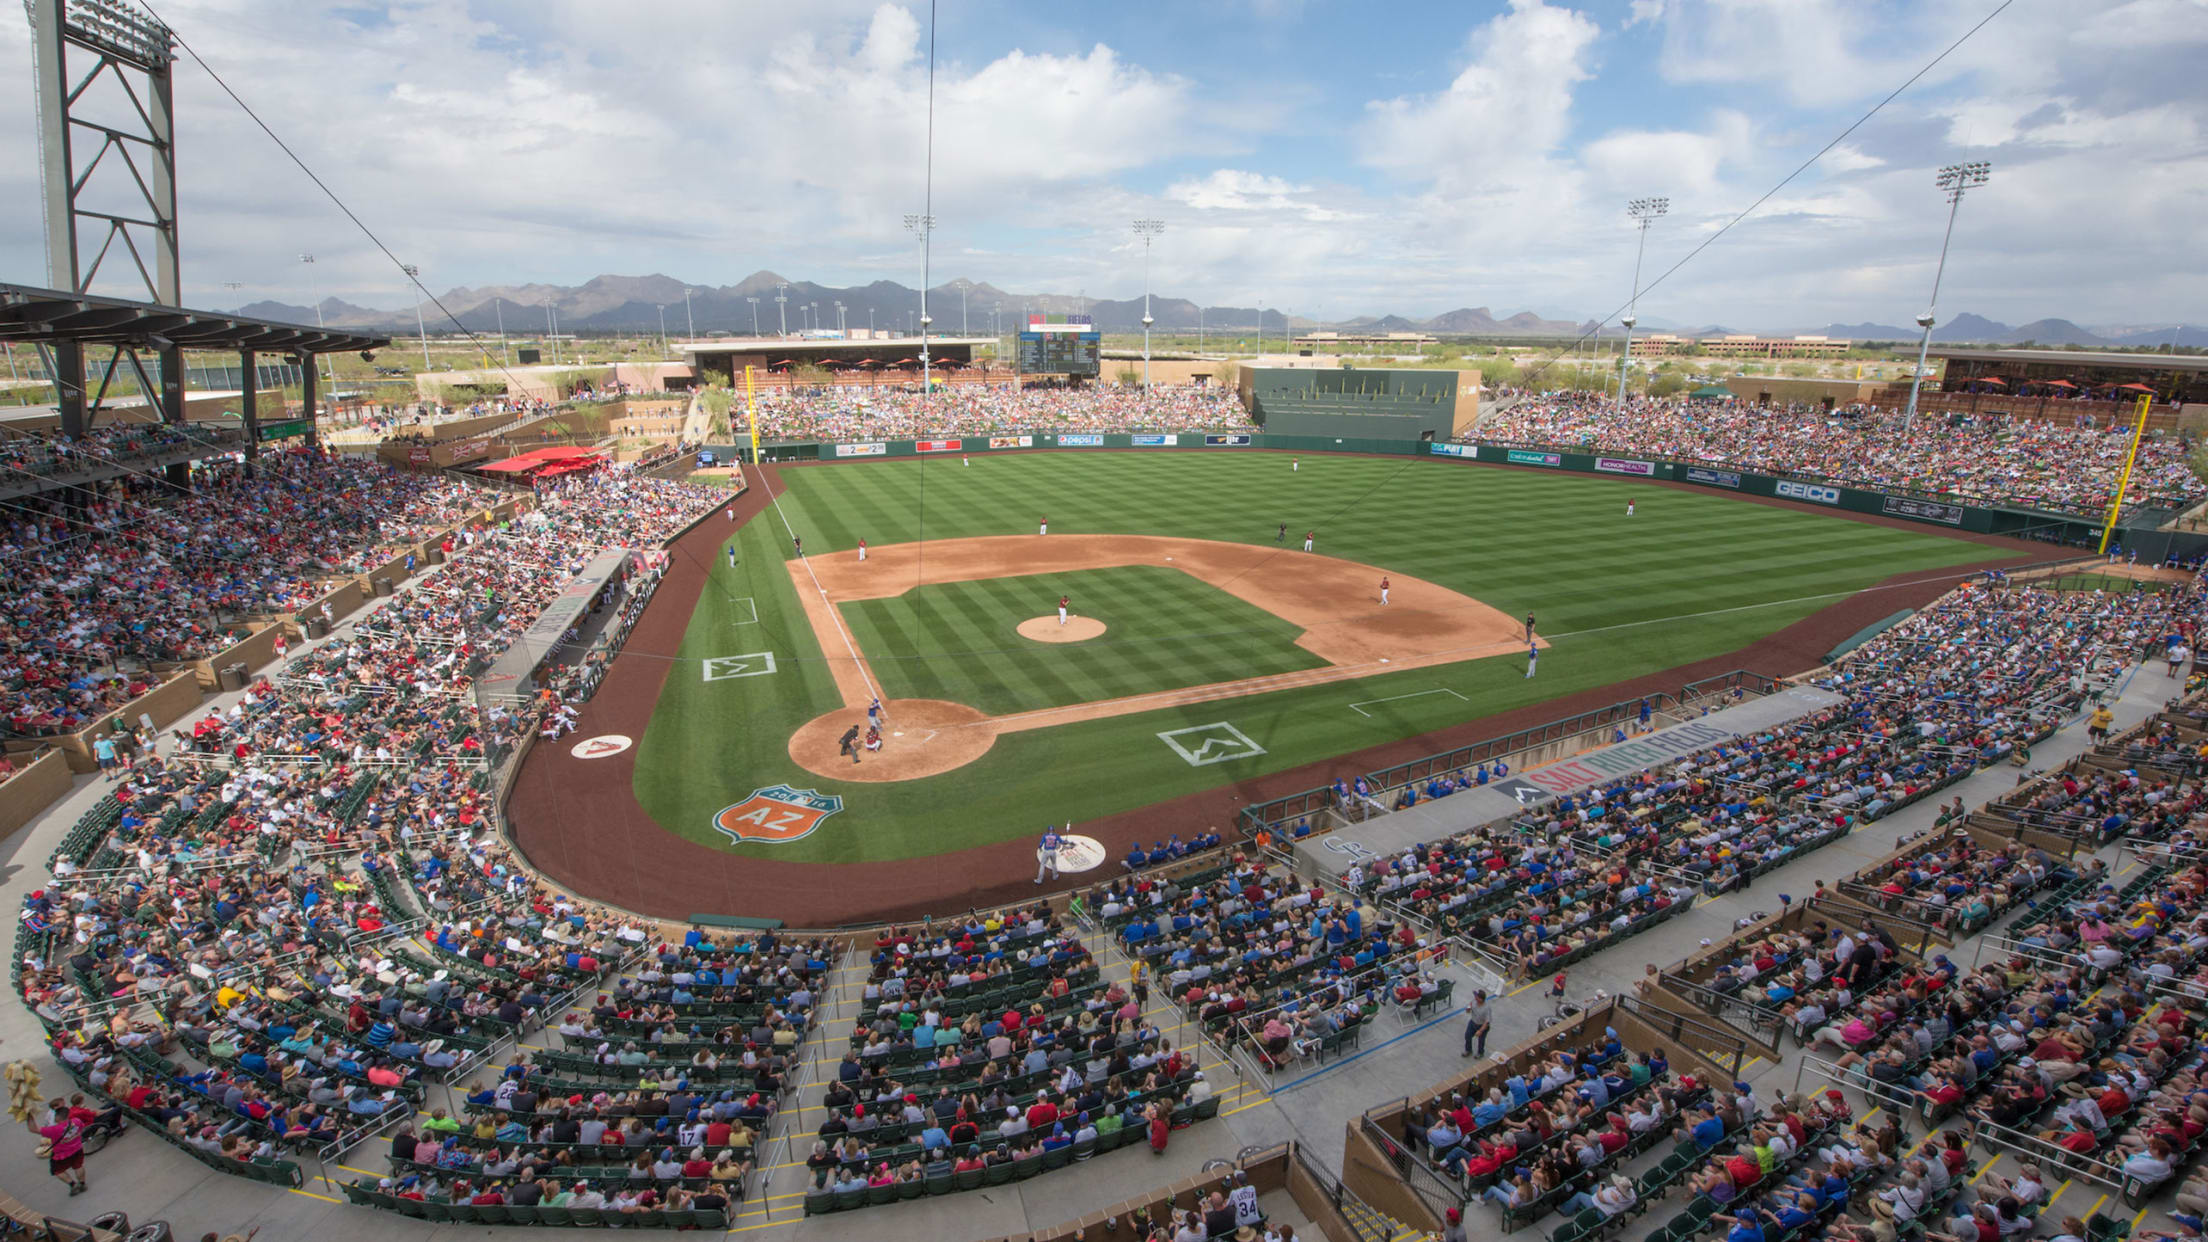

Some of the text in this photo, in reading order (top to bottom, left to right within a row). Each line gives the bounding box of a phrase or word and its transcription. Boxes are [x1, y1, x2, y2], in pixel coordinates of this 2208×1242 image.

[1776, 481, 1839, 503] GEICO
[1529, 722, 1730, 792] SALT RIVER FIELDS
[735, 806, 805, 832] AZ
[681, 1132, 696, 1146] 17
[1238, 1200, 1257, 1217] 34
